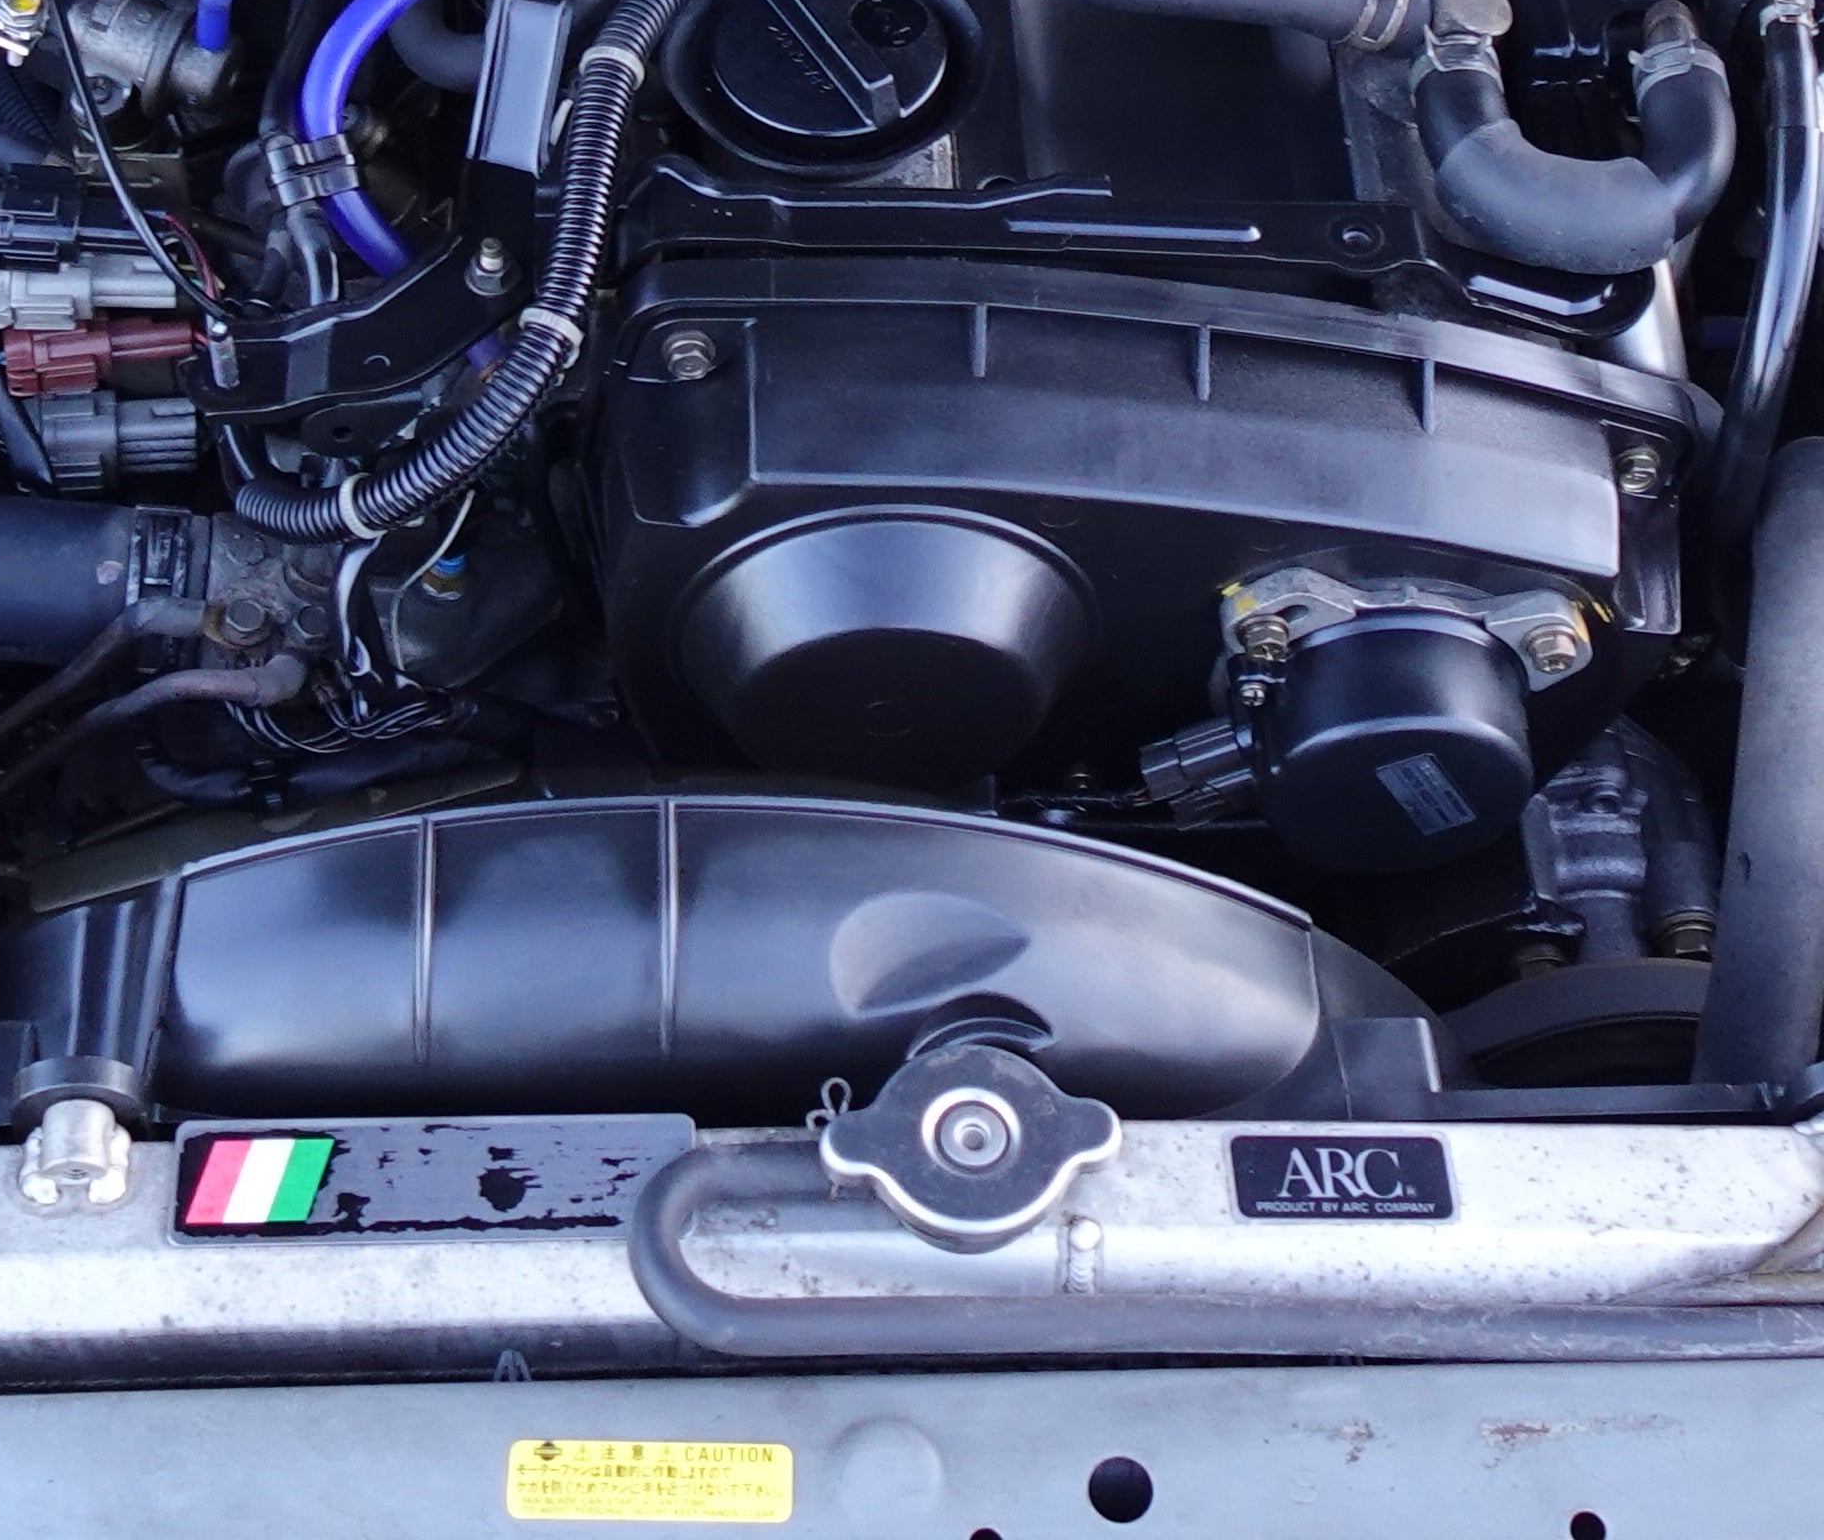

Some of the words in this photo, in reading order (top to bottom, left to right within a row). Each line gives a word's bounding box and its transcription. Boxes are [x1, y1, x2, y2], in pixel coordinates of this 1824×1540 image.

[1277, 1147, 1404, 1199] ARC
[1255, 1200, 1316, 1213] PRODUCT
[1322, 1201, 1340, 1213] BY
[1342, 1202, 1370, 1214] ARC
[1375, 1202, 1437, 1215] COMPANY
[600, 1444, 645, 1461] 注意
[684, 1445, 774, 1463] CAUTION
